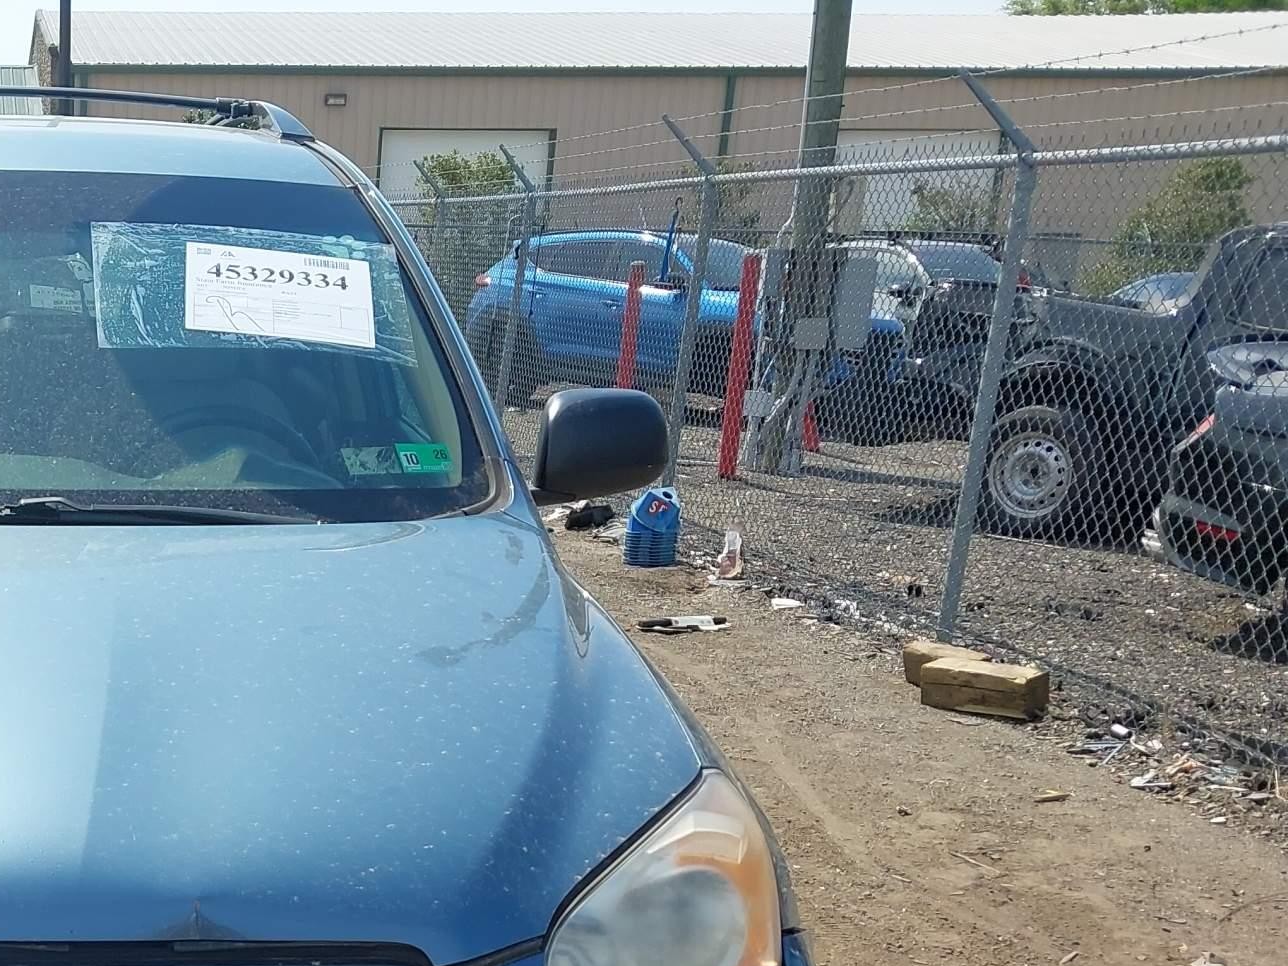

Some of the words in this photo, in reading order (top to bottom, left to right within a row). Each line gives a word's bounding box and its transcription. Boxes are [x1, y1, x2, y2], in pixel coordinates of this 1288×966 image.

[206, 262, 349, 291] 45329334
[403, 453, 420, 466] 10
[433, 448, 448, 460] 26
